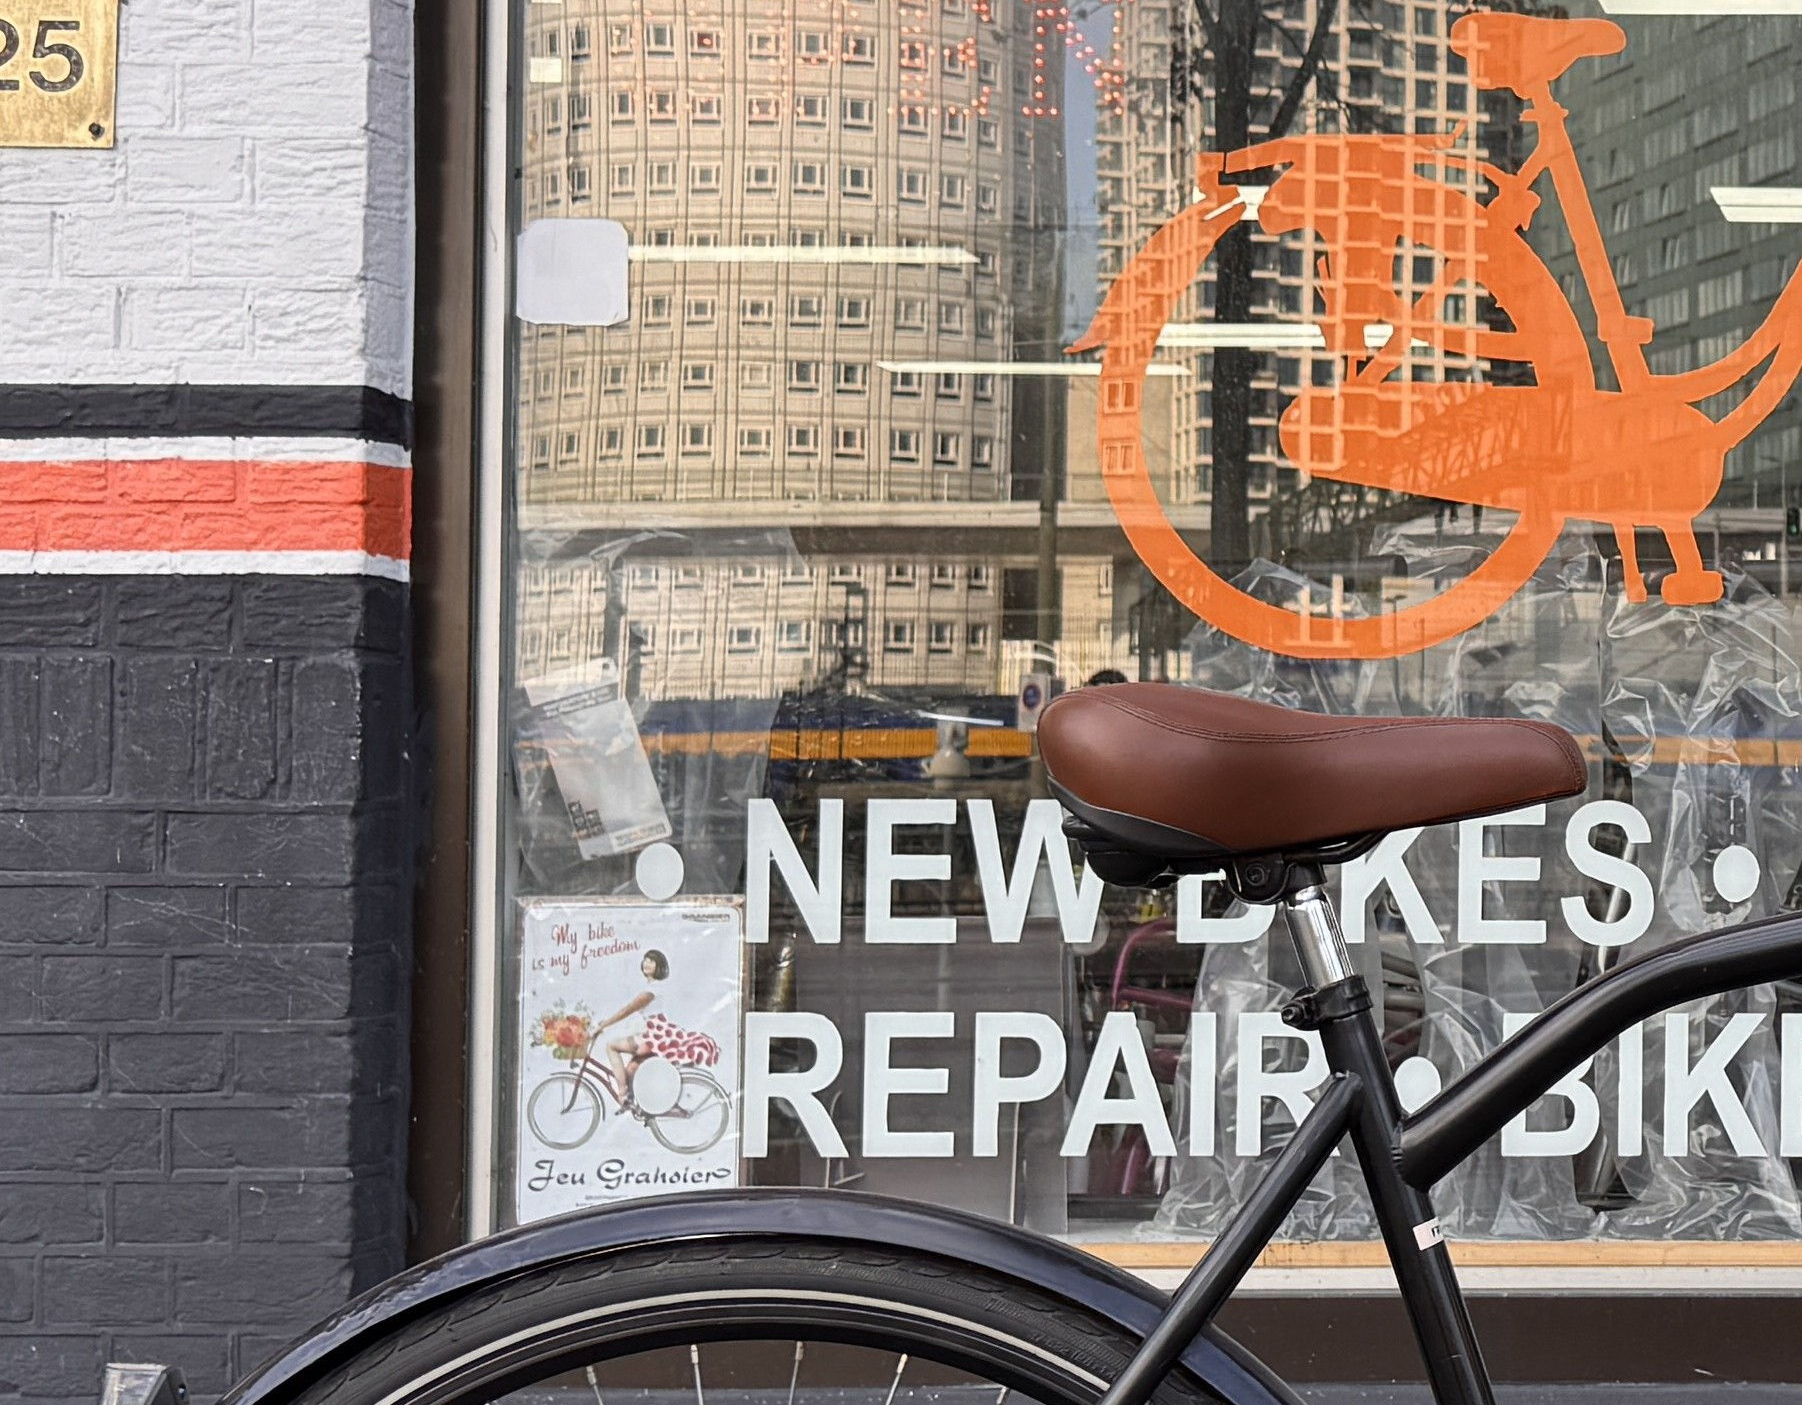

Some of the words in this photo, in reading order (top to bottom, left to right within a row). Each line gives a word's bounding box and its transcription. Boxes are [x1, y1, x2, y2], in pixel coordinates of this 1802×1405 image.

[744, 798, 1105, 944] NEW
[551, 923, 578, 954] My
[588, 921, 617, 941] bike
[532, 958, 545, 971] is
[550, 954, 570, 976] my
[579, 938, 641, 970] freedom
[743, 1011, 1342, 1158] REPAIR
[528, 1158, 586, 1192] Jeu
